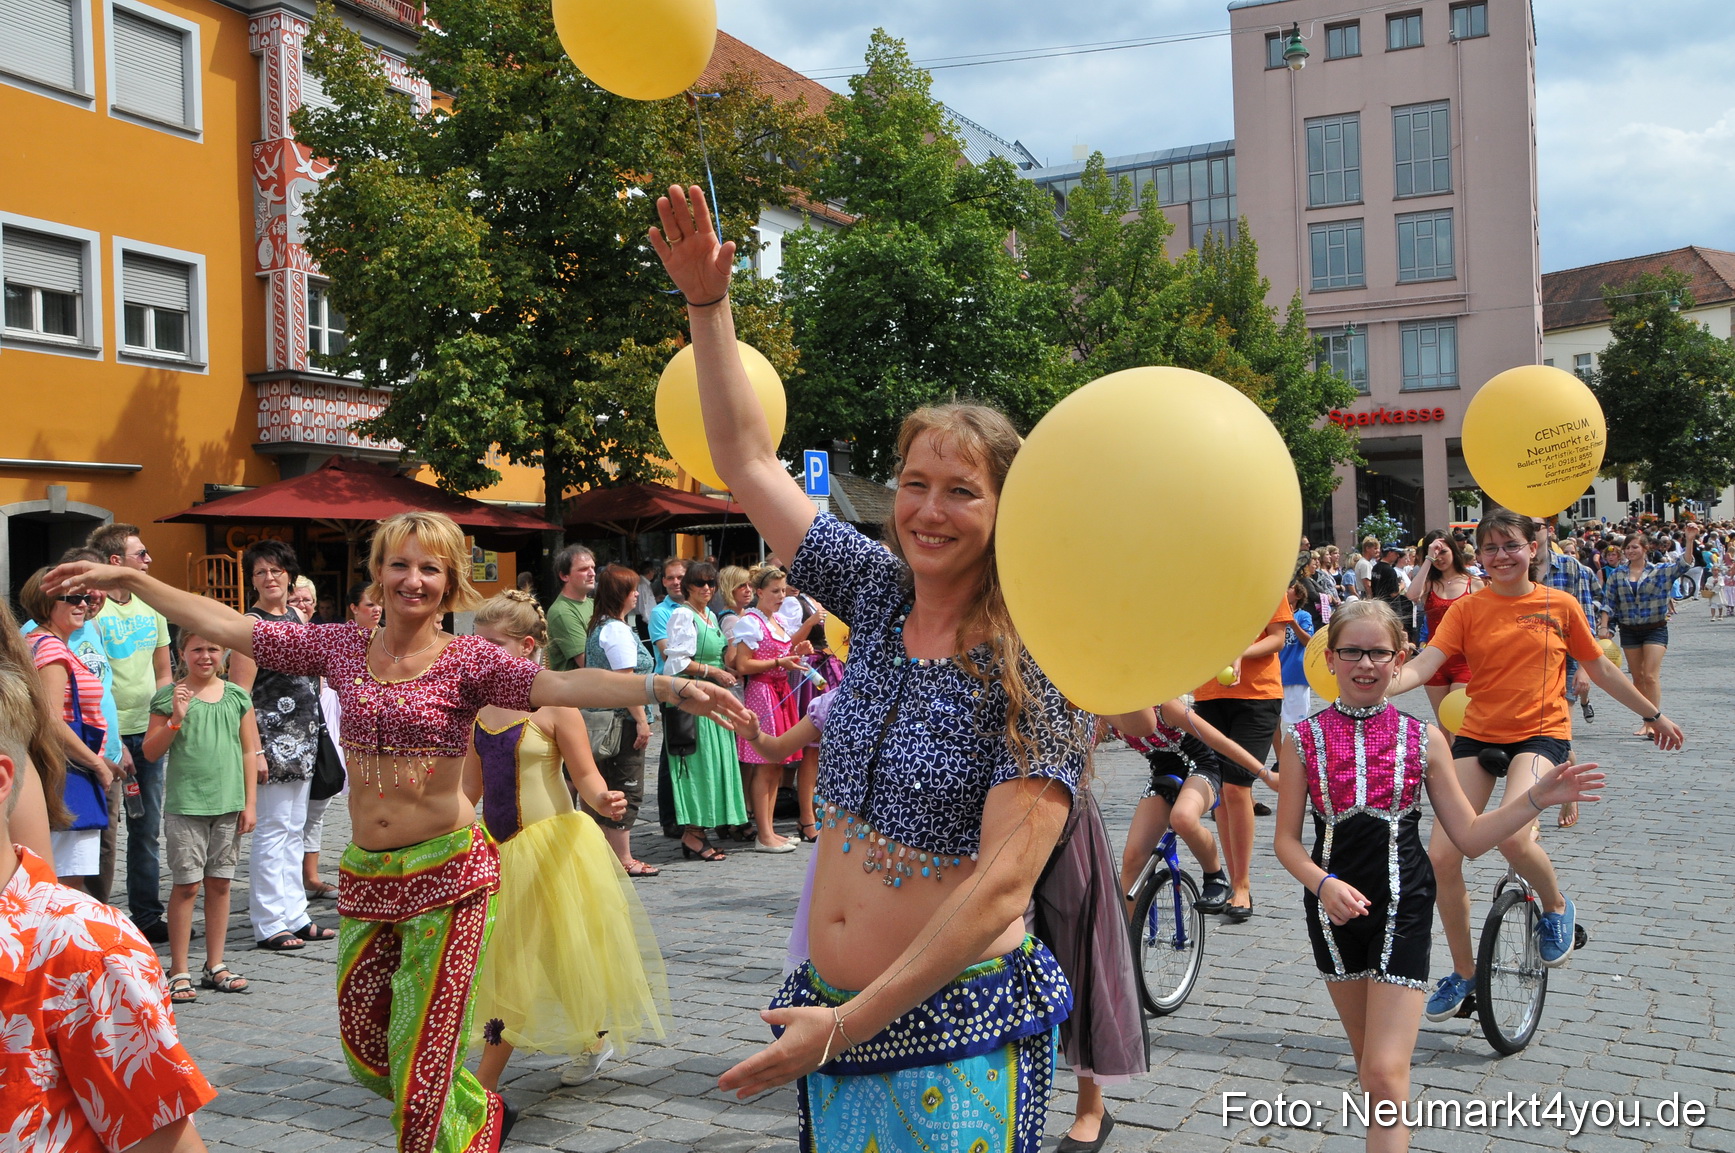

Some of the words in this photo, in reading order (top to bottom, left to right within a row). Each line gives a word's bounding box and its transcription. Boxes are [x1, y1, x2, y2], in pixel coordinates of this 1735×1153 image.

[1328, 407, 1445, 430] Sparkasse
[1534, 418, 1590, 442] CENTRUM
[1526, 435, 1582, 458] Neumarkt
[1584, 429, 1598, 442] e.V.
[1544, 463, 1587, 478] Gartenstraße
[1557, 456, 1578, 467] 09181
[1578, 451, 1593, 461] 8555
[809, 456, 823, 490] P
